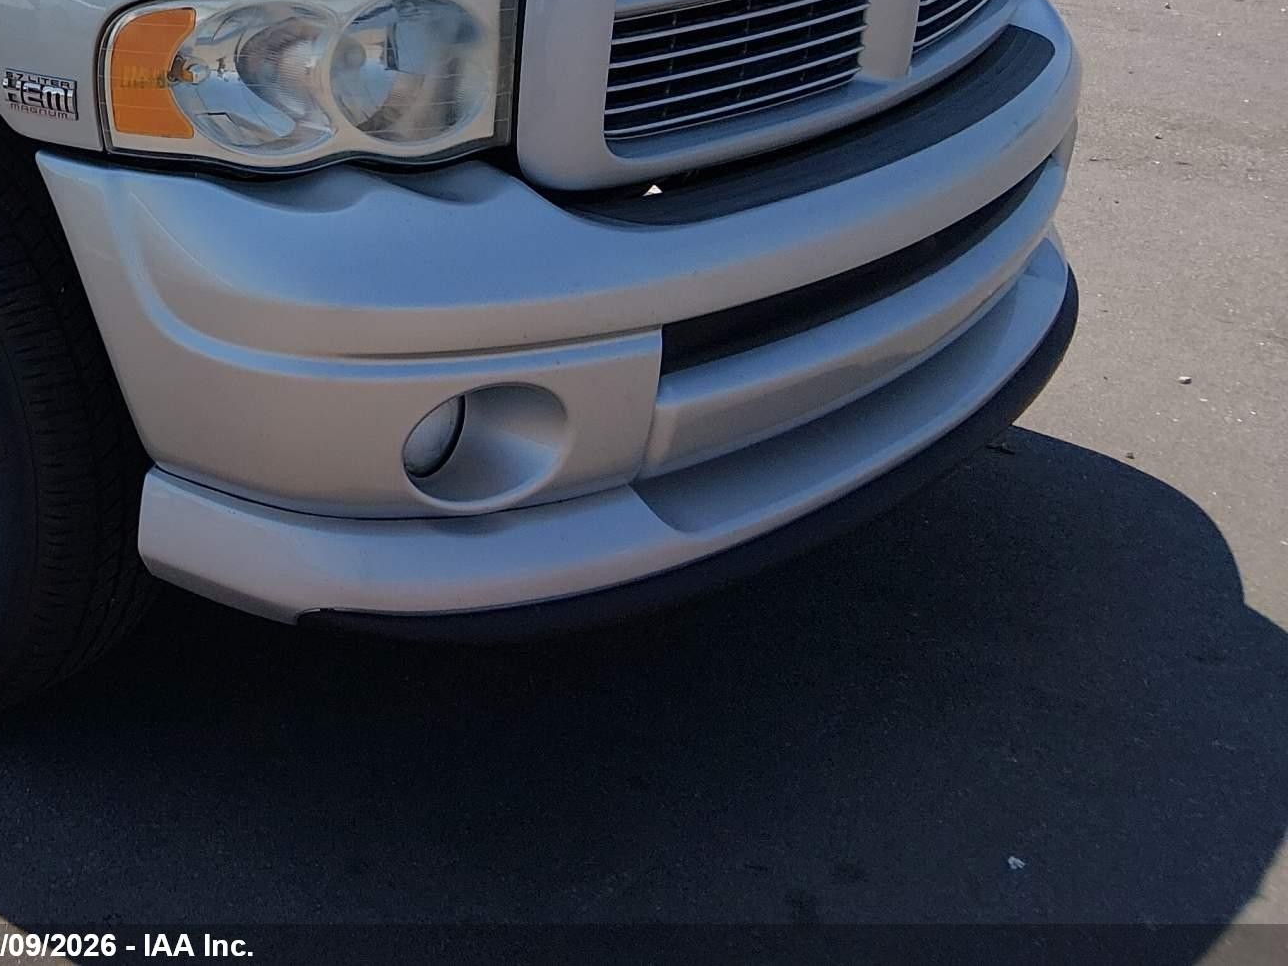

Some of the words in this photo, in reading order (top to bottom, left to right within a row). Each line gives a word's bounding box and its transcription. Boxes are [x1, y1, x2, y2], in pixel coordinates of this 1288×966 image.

[28, 76, 71, 89] LITER
[2, 77, 76, 115] HEMI
[9, 103, 68, 120] MAGNUM
